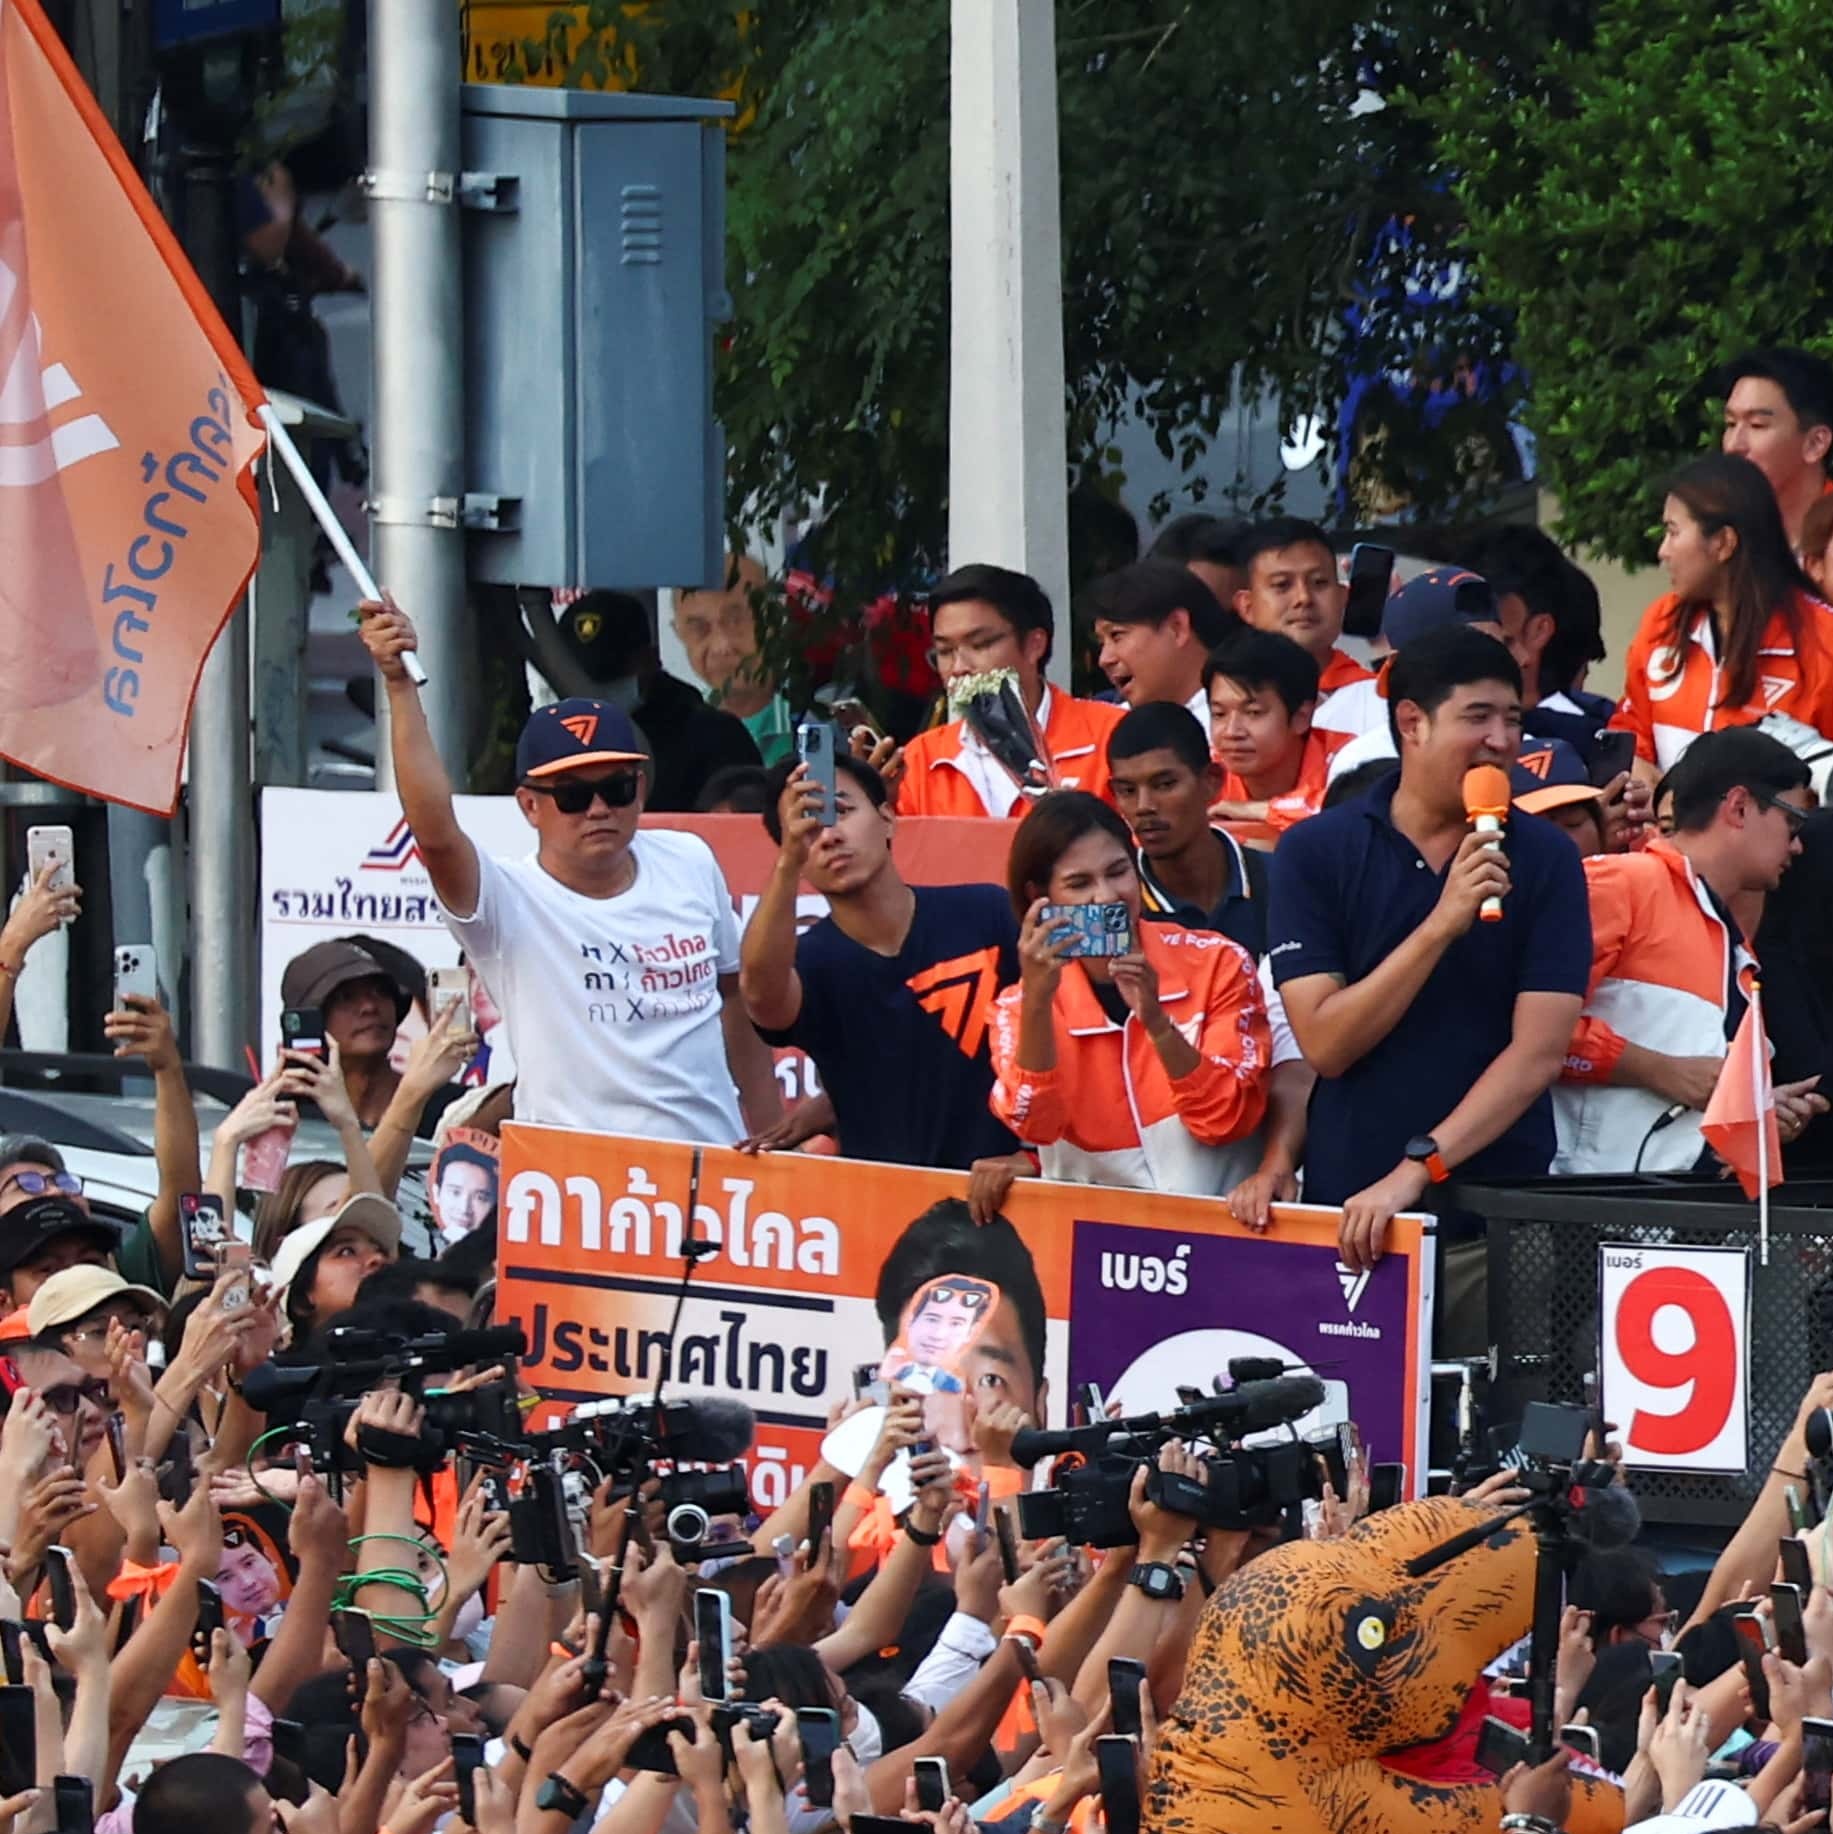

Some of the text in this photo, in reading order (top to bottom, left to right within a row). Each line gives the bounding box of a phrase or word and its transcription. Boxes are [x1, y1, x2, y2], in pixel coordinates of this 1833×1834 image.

[584, 971, 615, 990] กา
[626, 997, 645, 1022] X
[1101, 1245, 1190, 1296] เบอร์
[1605, 1253, 1644, 1271] เบอร์
[1319, 1321, 1381, 1340] พรรคก้าวไกล
[508, 1304, 828, 1398] ประเทศไทย
[1615, 1265, 1738, 1456] 9
